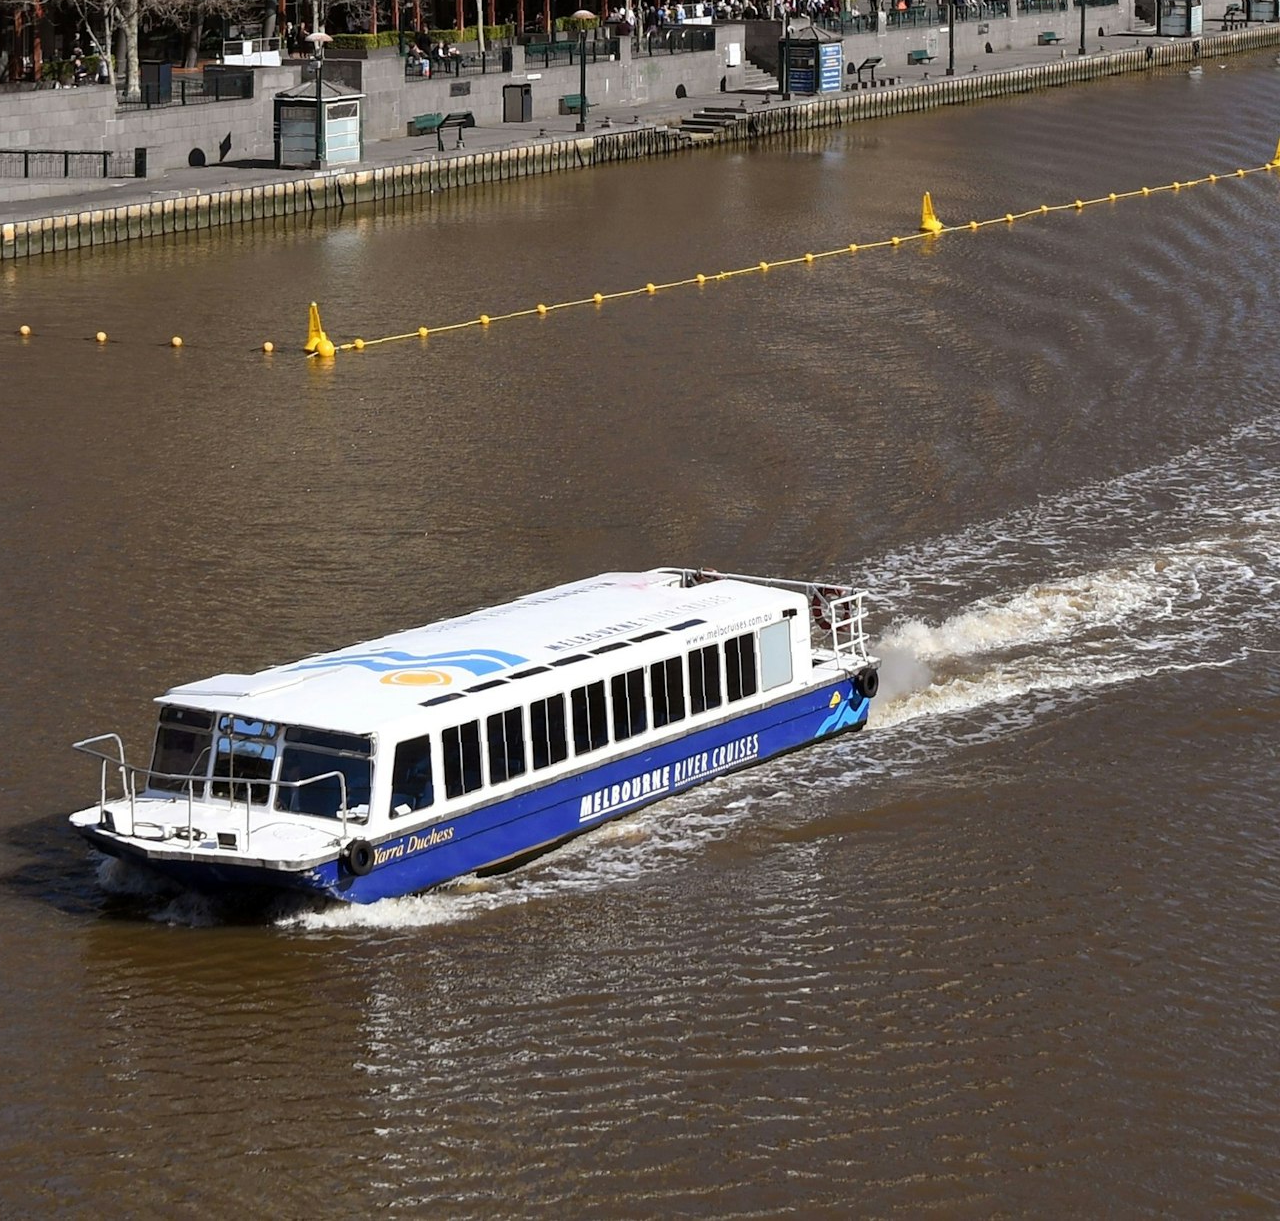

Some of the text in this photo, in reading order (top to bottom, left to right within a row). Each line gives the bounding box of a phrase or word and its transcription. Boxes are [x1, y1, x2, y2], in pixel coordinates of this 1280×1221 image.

[544, 620, 642, 651] MELBOURNE
[580, 733, 759, 818] MELBOURNE RIVER CRUISES
[373, 826, 455, 865] Yarra Duchess
